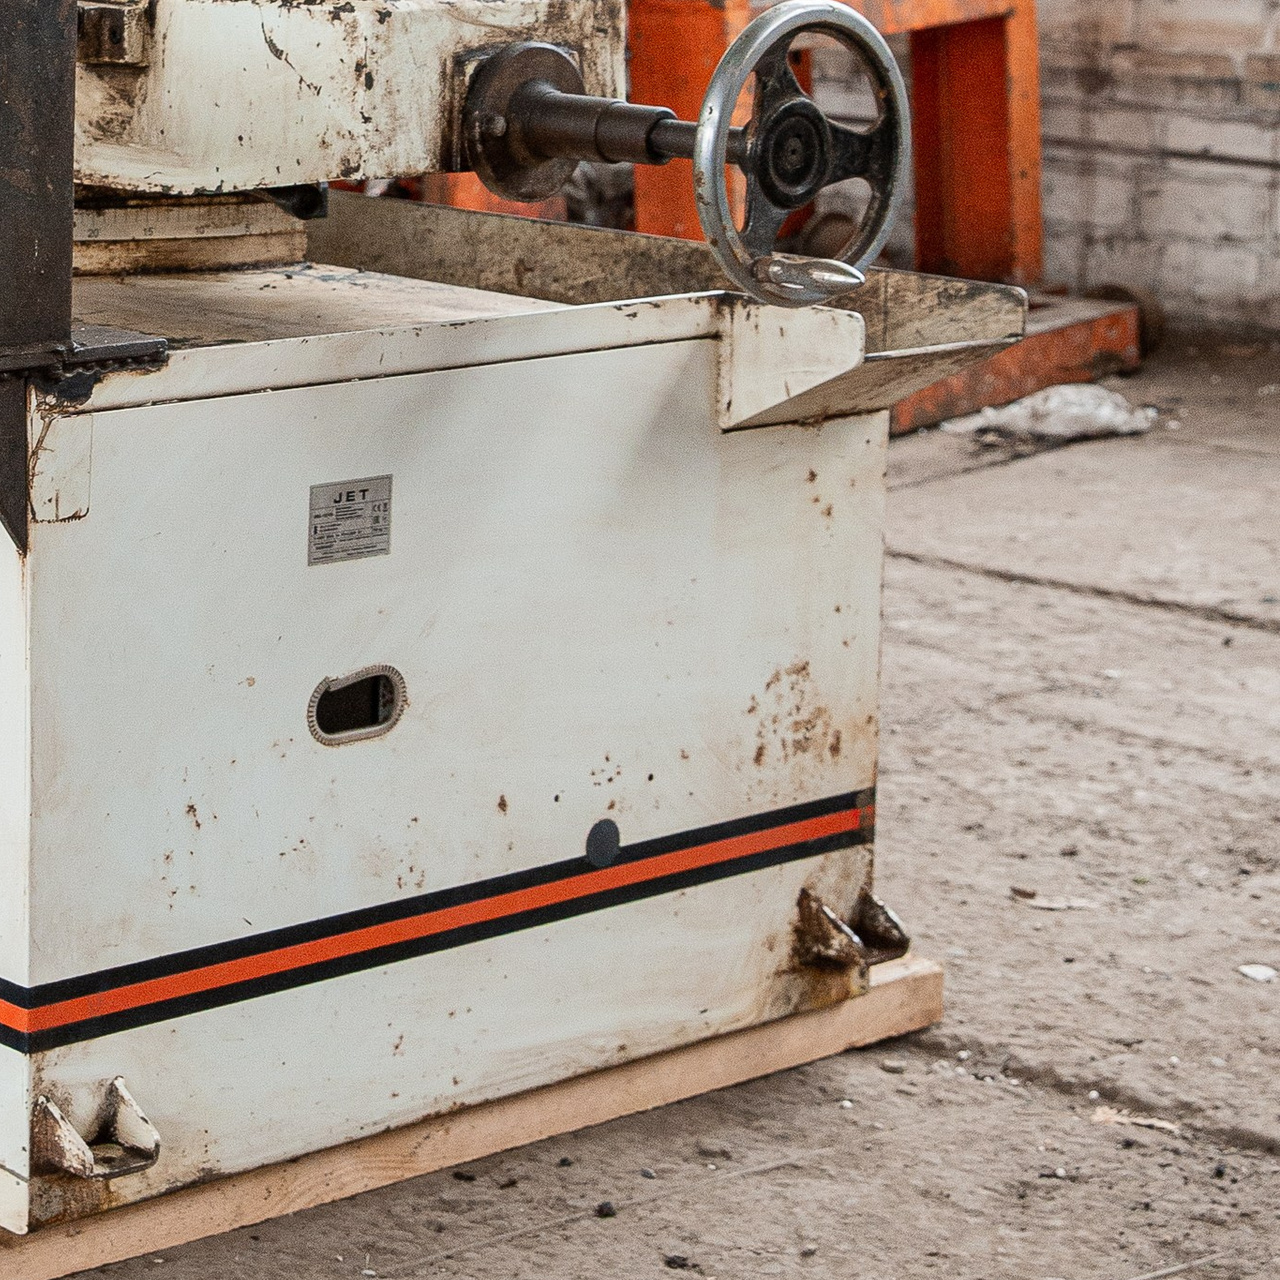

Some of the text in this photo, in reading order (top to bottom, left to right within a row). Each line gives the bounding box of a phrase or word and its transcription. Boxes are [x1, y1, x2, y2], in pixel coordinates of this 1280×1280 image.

[87, 228, 99, 238] 20
[143, 226, 154, 236] 15
[333, 488, 370, 504] JET
